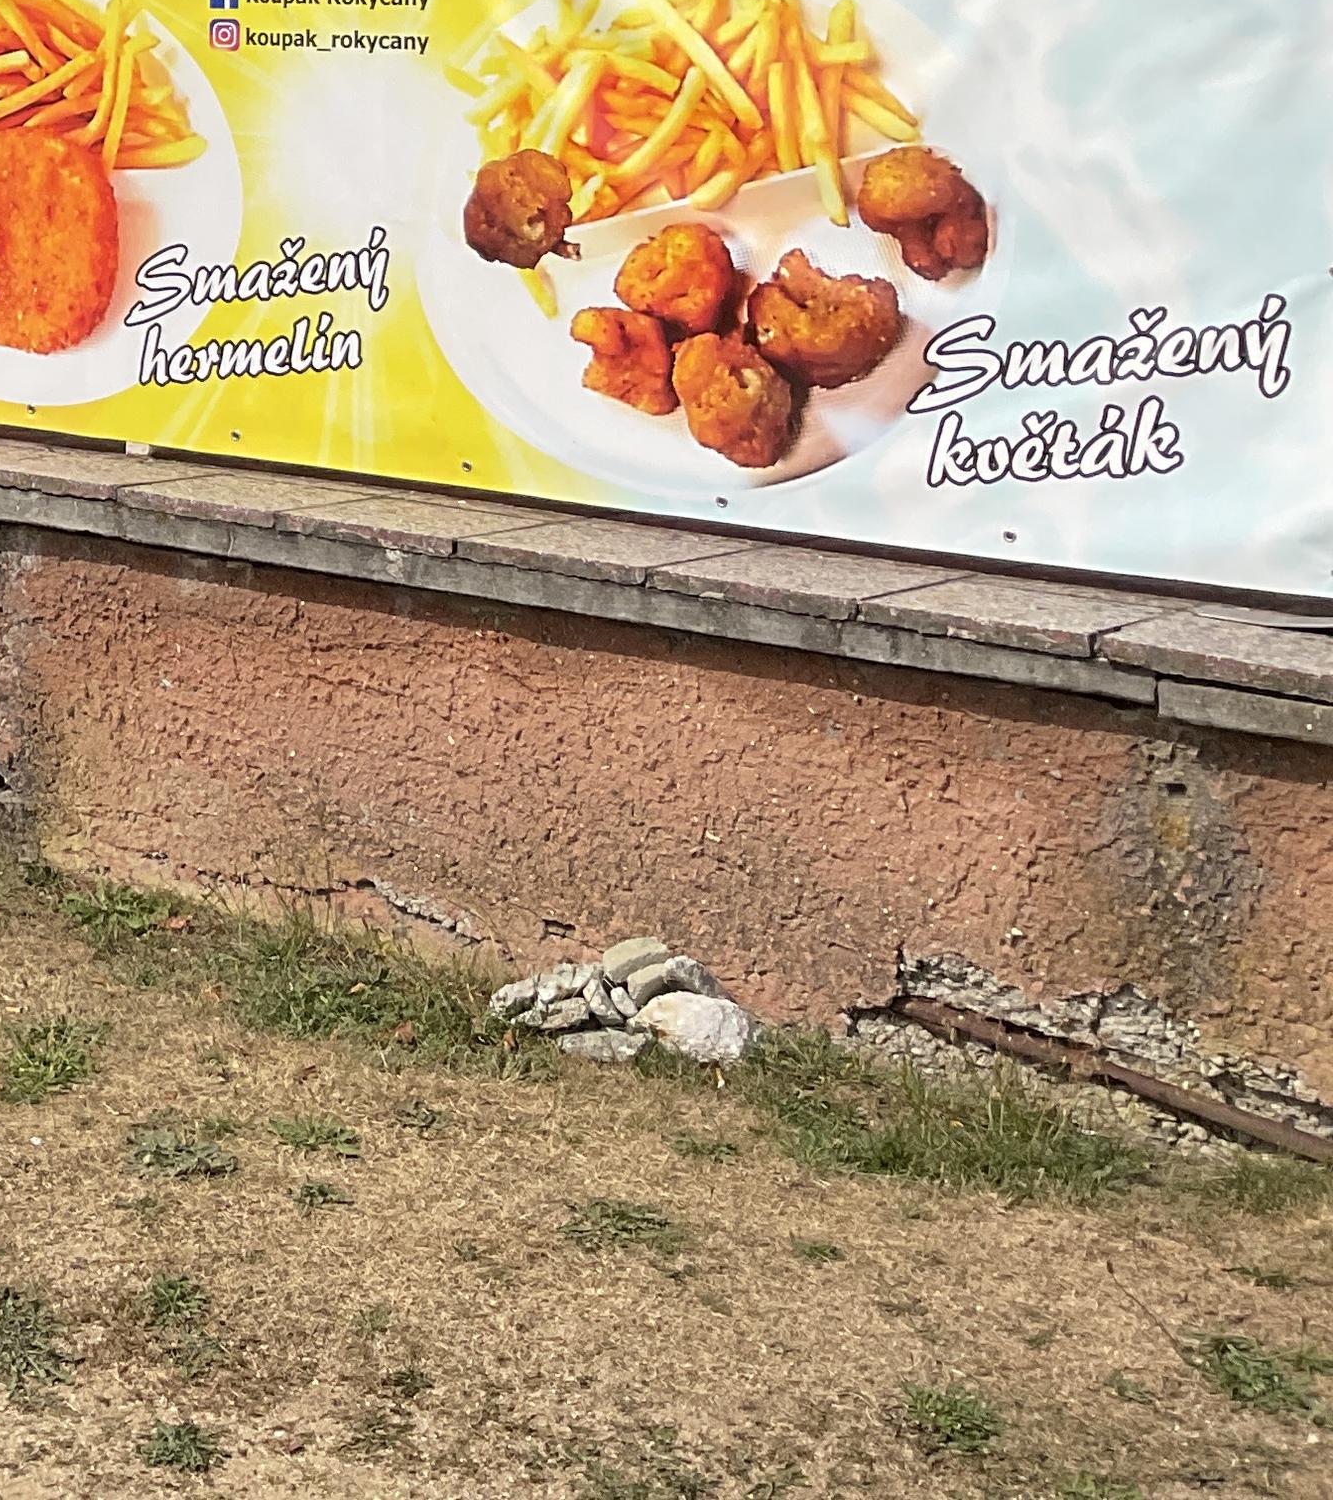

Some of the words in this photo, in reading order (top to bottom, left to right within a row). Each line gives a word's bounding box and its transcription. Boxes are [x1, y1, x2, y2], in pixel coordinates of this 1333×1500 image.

[245, 26, 430, 55] koupak_rokycany
[124, 225, 390, 327] Smažený
[139, 315, 364, 387] hermelín
[906, 294, 1293, 415] Smažený
[928, 394, 1185, 488] květák
